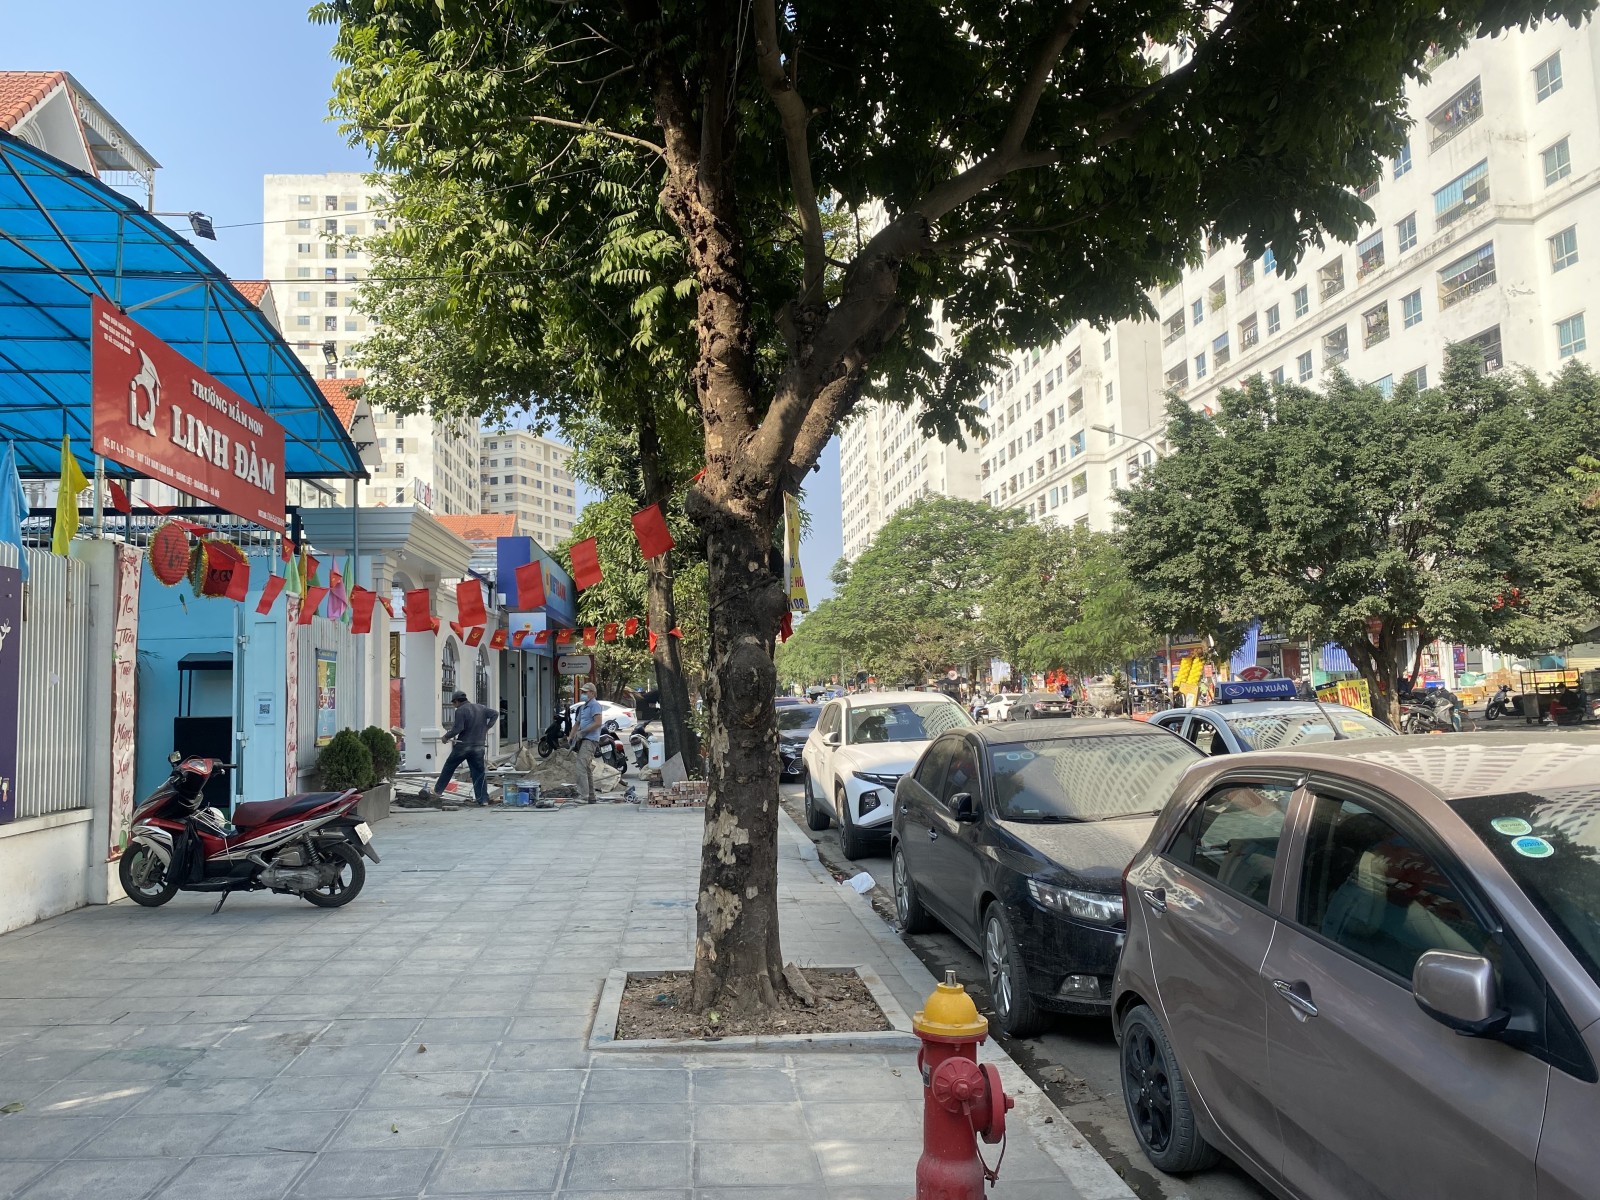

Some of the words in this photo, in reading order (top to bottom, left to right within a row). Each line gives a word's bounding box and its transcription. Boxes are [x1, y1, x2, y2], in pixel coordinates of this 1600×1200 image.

[191, 378, 228, 414] TRƯỜNG
[248, 416, 264, 437] NON
[170, 404, 230, 470] LINH
[234, 440, 276, 495] ĐÀM
[1245, 686, 1264, 695] VẠN
[1265, 682, 1289, 693] XUÂN
